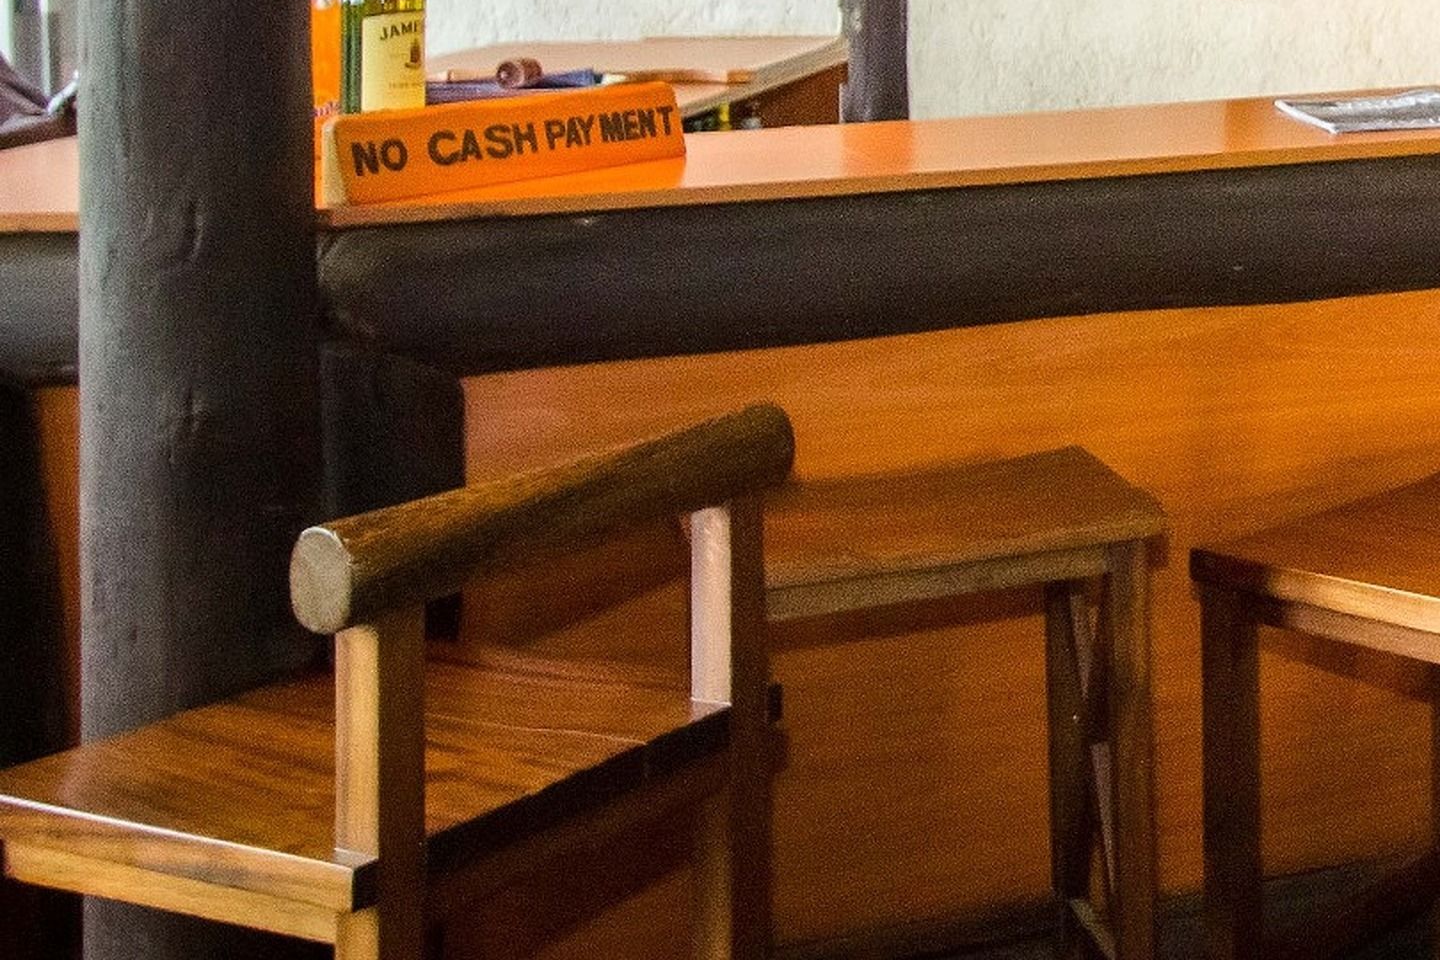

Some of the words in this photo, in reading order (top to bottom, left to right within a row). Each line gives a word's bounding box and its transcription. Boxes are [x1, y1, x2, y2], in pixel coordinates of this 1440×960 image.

[351, 139, 408, 176] NO
[427, 122, 538, 166] CASH
[543, 106, 674, 150] PAYMENT
